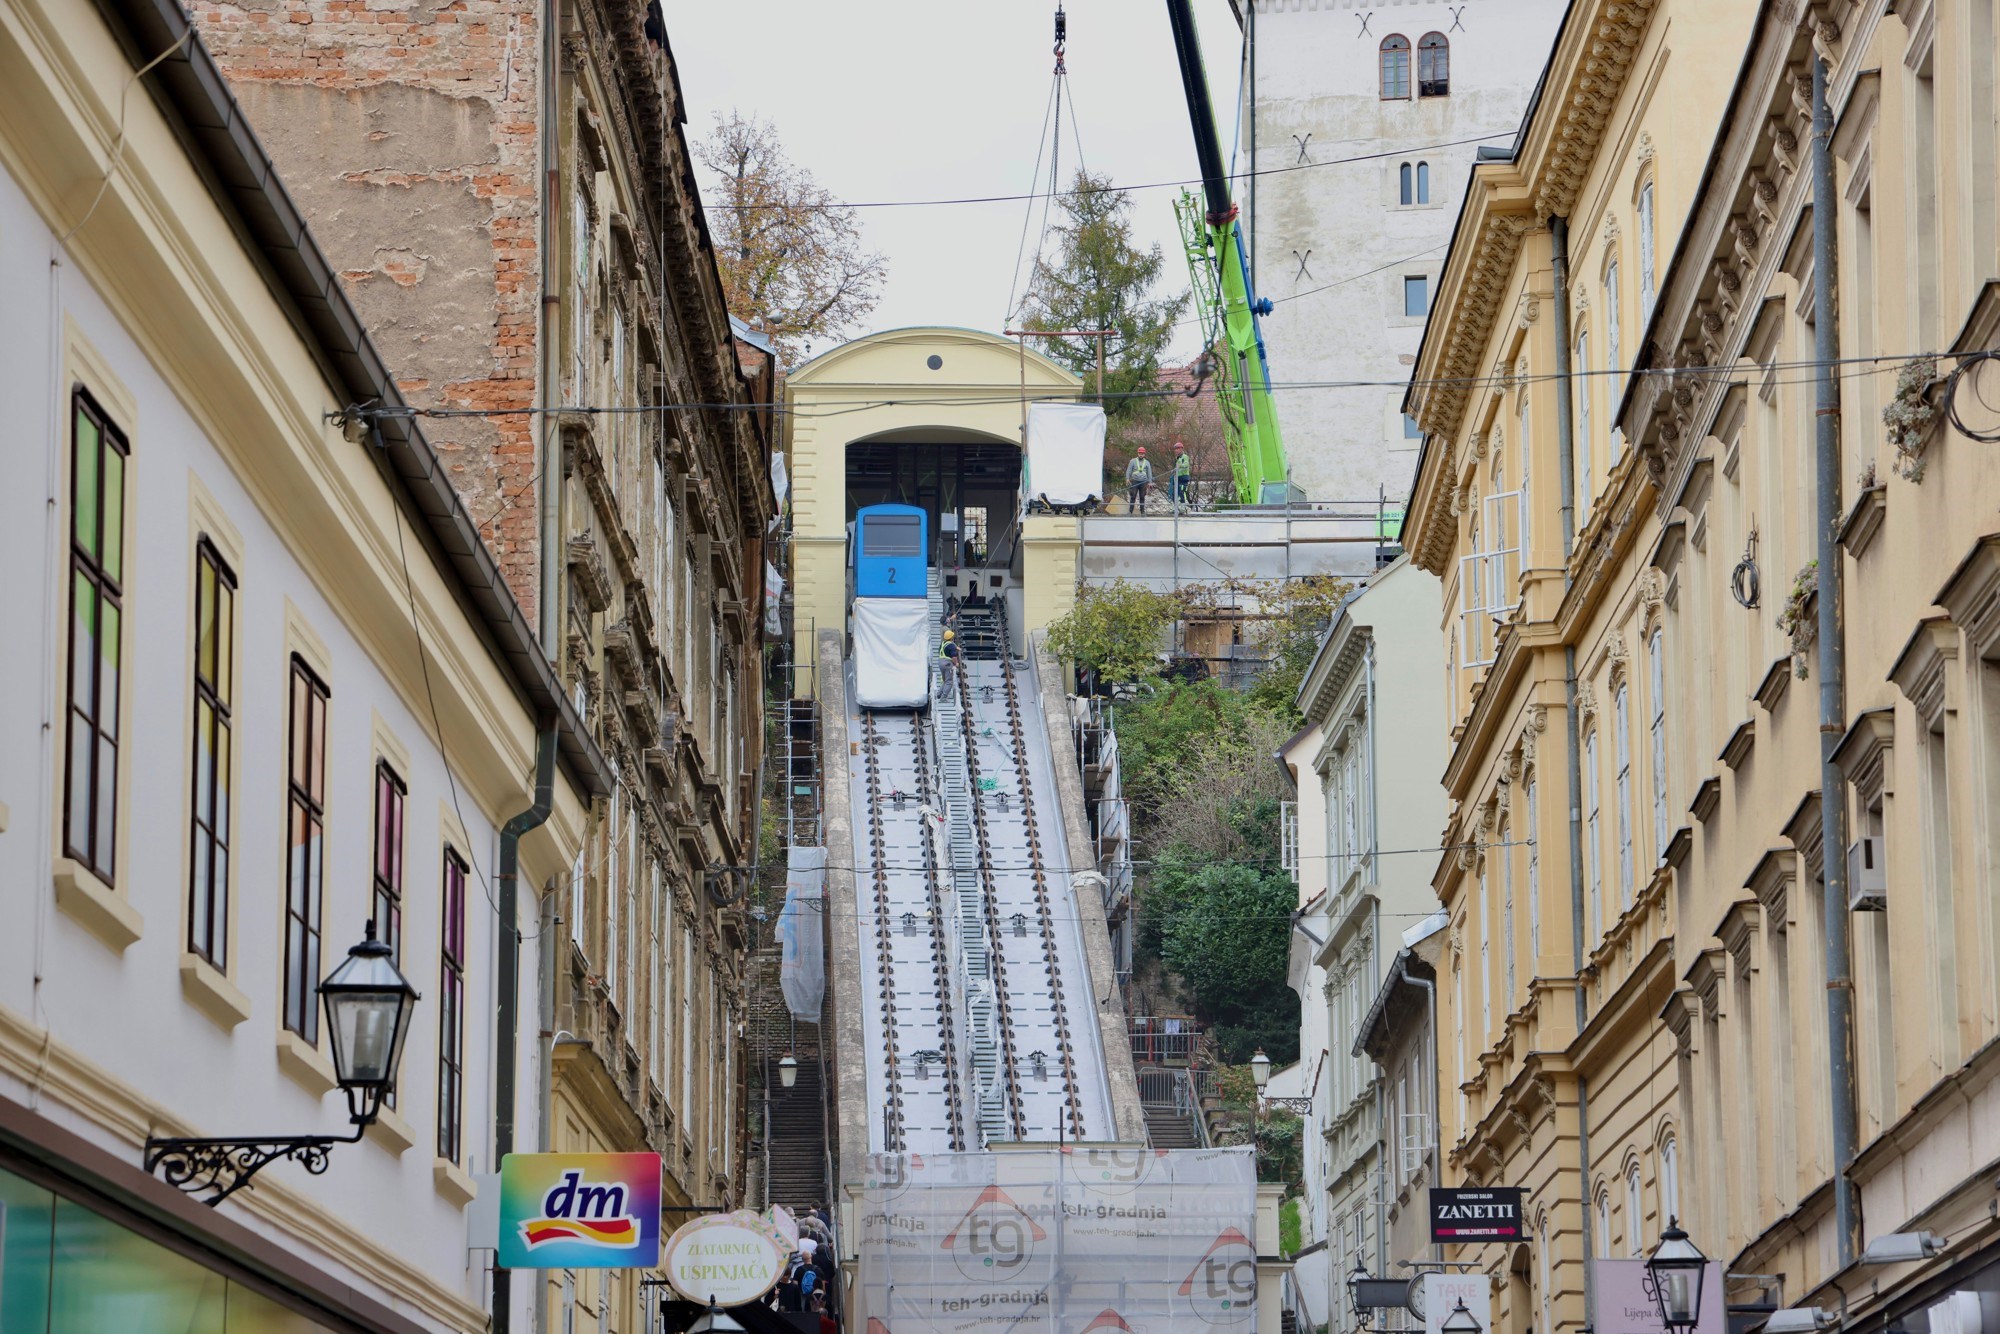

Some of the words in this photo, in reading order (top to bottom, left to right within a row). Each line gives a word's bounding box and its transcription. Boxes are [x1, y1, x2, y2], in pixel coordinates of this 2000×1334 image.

[888, 567, 896, 584] 2
[545, 1172, 624, 1219] dm
[1061, 1200, 1167, 1221] teh-gradnja
[1438, 1204, 1514, 1219] ZANETTI
[1073, 1227, 1157, 1239] www.teh-gradnja.hr
[687, 1243, 761, 1256] ZLATARNICA
[680, 1259, 769, 1281] USPINJAČA
[1436, 1283, 1477, 1298] TAKE
[941, 1289, 1049, 1312] teh-gradnja
[1624, 1307, 1652, 1320] Lijepa
[954, 1315, 1041, 1331] www.teh-gradnja.hr
